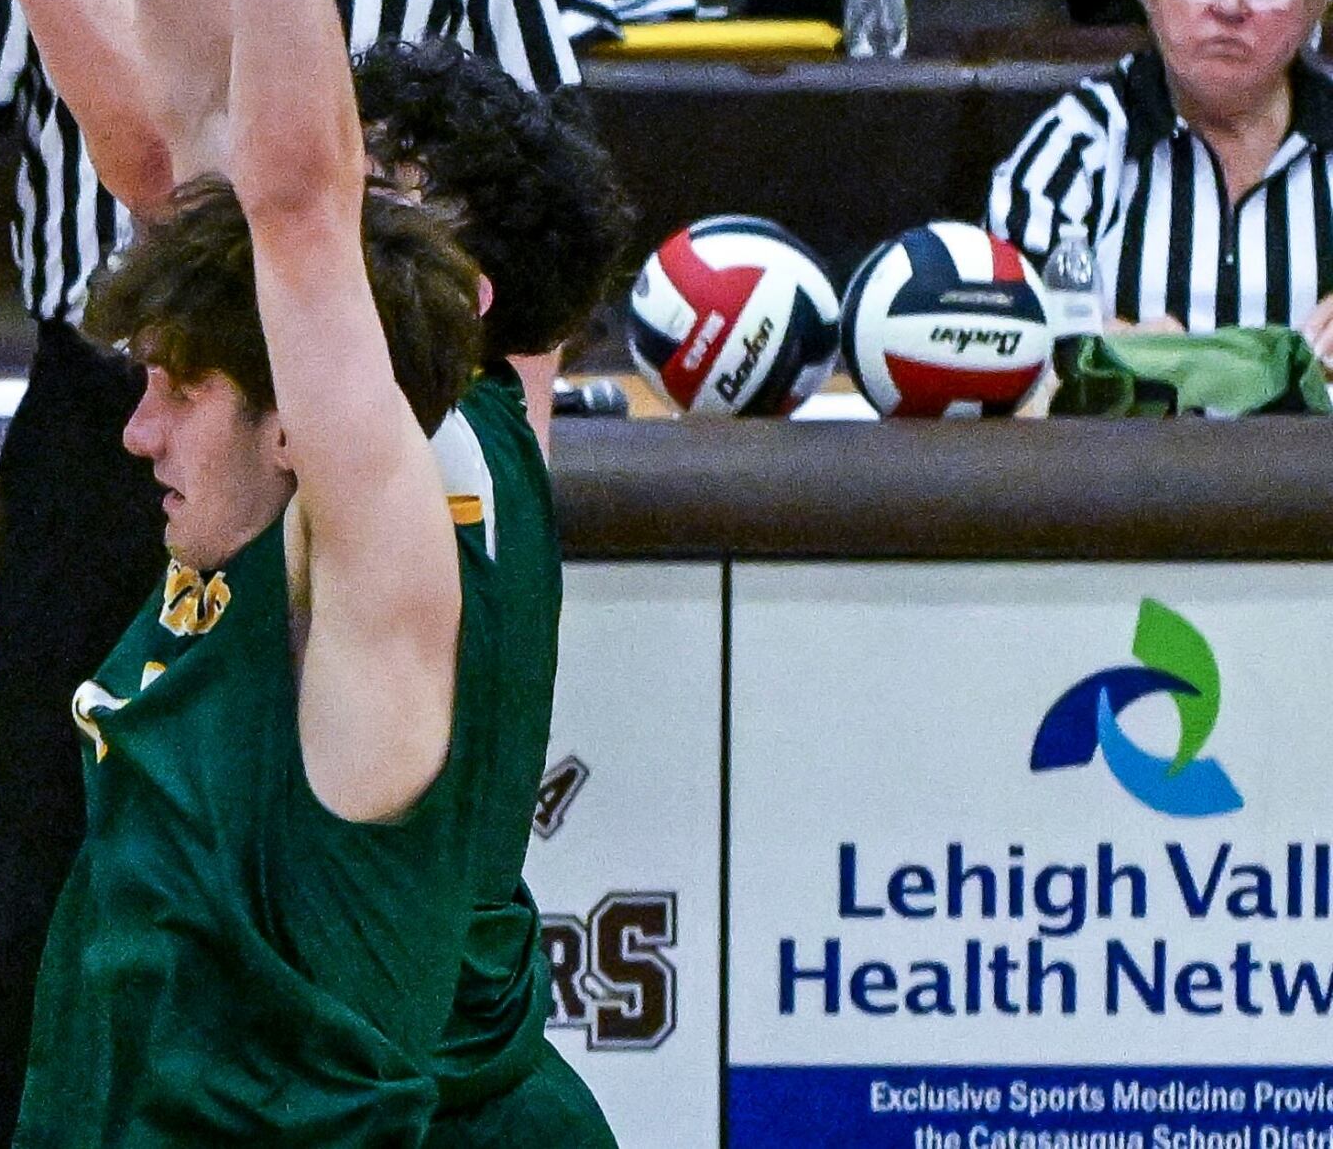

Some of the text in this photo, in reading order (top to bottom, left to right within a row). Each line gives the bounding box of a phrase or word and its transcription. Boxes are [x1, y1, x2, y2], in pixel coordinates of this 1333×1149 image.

[838, 842, 1333, 938] Lehigh Vall
[777, 938, 1333, 1015] Health Netw
[869, 1080, 1002, 1113] Exclusive
[1009, 1080, 1106, 1117] Sports
[1112, 1080, 1247, 1113] Medicine
[914, 1124, 962, 1149] the
[1152, 1124, 1252, 1149] School
